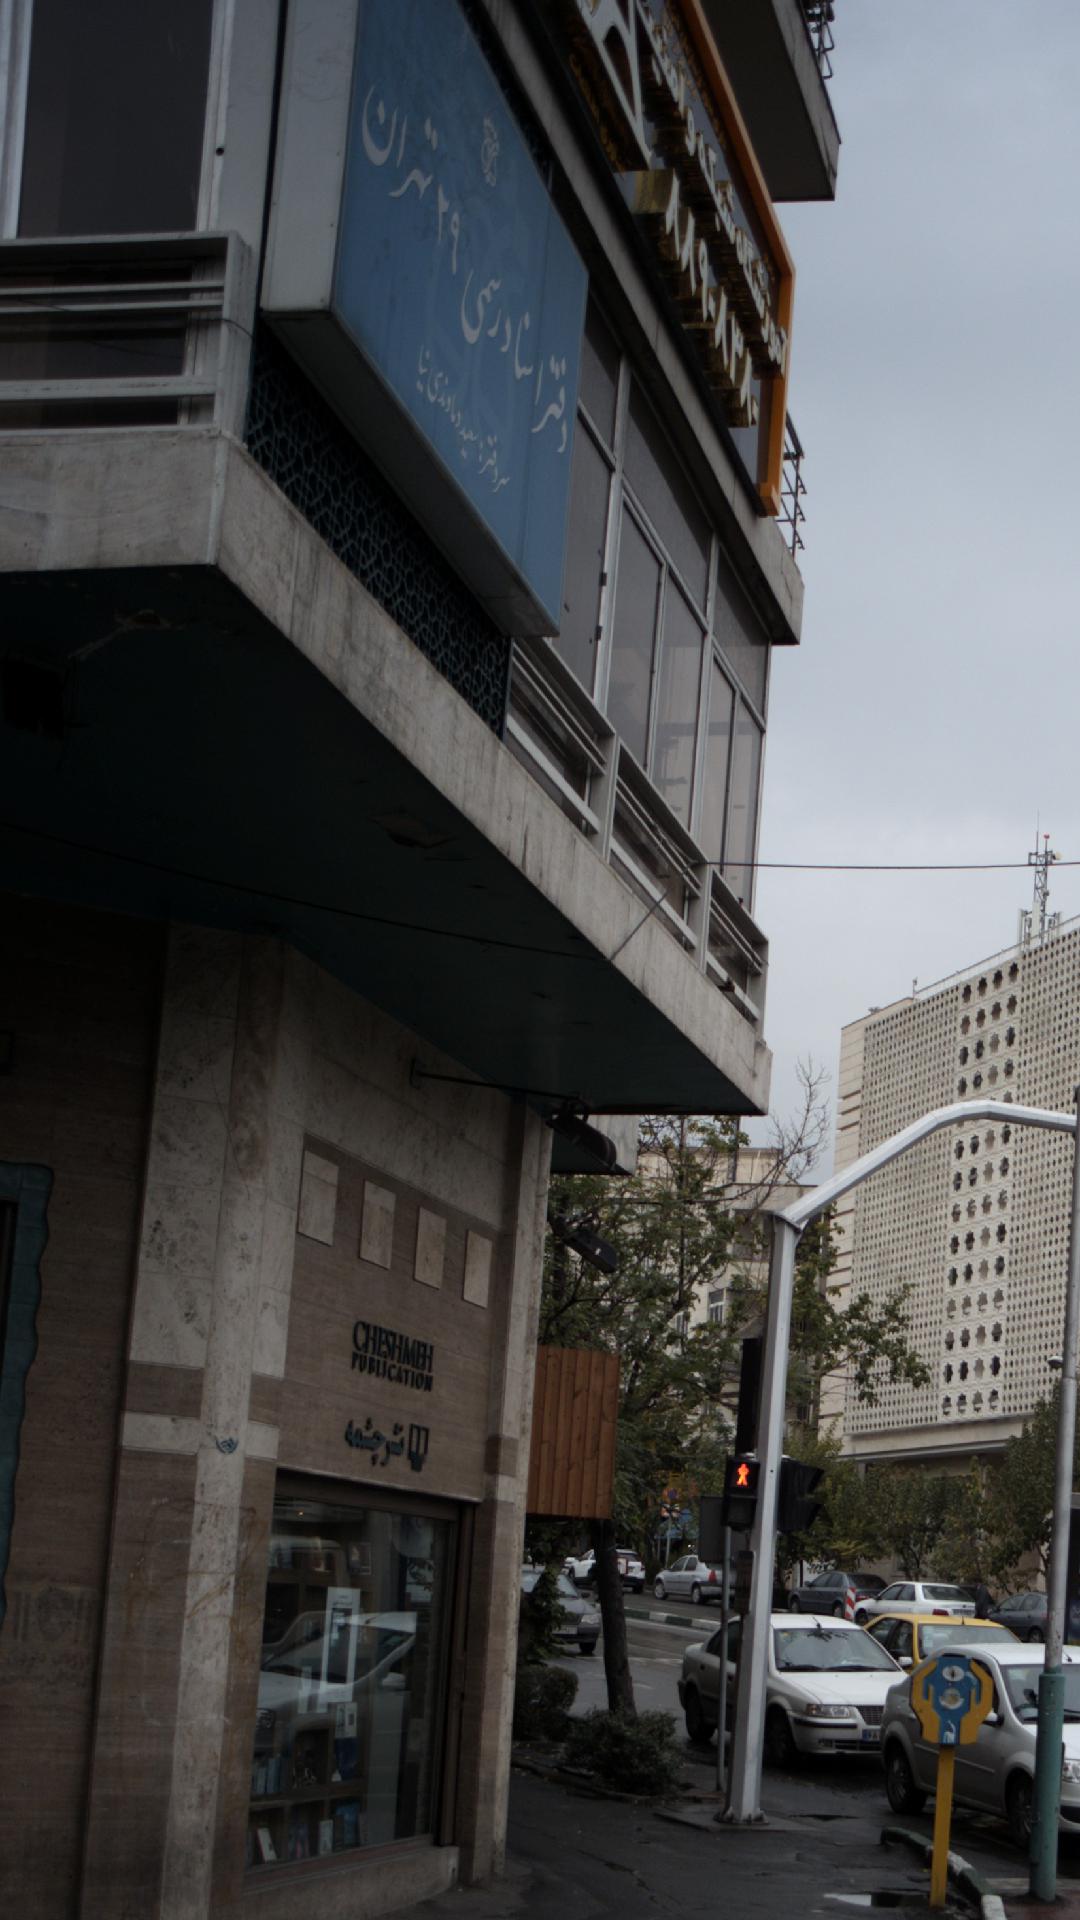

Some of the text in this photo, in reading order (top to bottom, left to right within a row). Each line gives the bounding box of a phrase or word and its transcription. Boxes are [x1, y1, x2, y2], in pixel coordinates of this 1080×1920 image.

[361, 84, 567, 453] دفتر اسناد رسمی ۲۹ تهران
[352, 1351, 433, 1392] PUBLICATION
[353, 1320, 433, 1373] CHESHMEH
